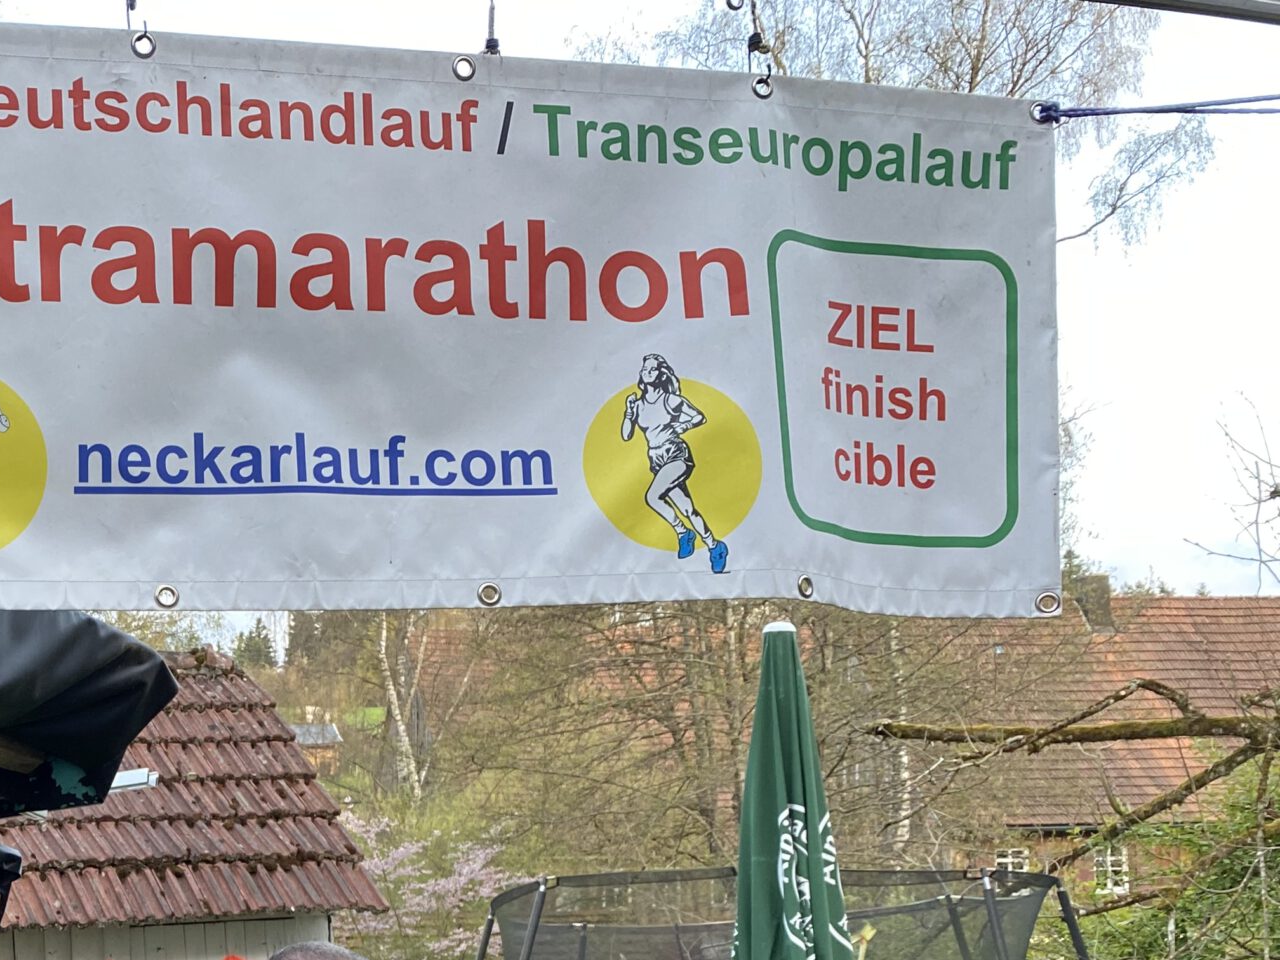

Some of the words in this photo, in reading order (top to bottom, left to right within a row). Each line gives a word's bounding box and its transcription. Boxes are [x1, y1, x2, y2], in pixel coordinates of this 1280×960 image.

[498, 102, 514, 154] /
[534, 105, 1017, 191] Transeuropalauf
[827, 302, 934, 353] ZIEL
[822, 368, 946, 421] finish
[77, 433, 554, 490] neckarlauf.com
[835, 442, 936, 489] cible
